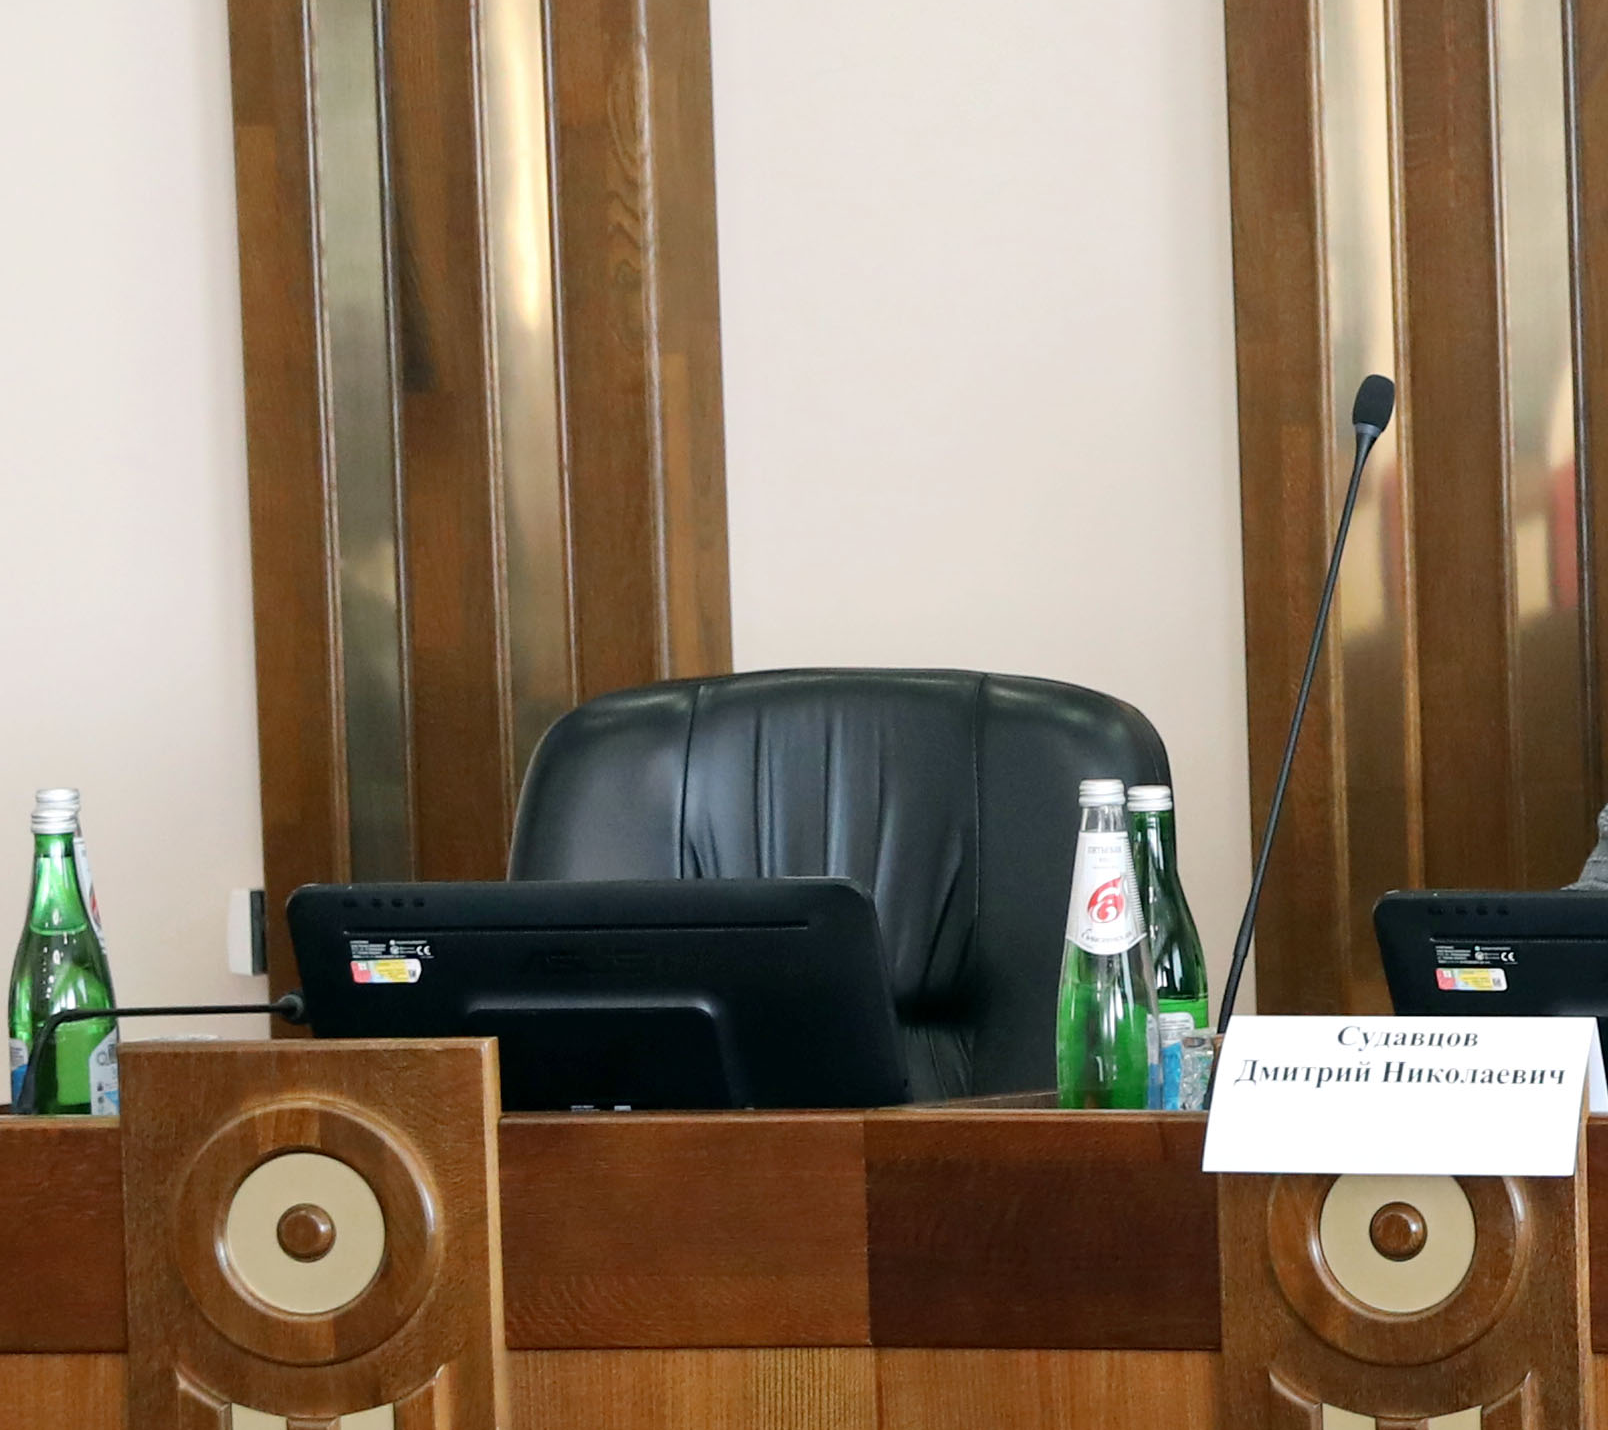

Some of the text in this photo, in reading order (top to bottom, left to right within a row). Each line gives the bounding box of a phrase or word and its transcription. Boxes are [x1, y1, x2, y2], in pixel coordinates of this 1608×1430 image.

[1337, 1025, 1479, 1052] Судавцов
[1234, 1059, 1565, 1089] Дмитрий Николаевич
